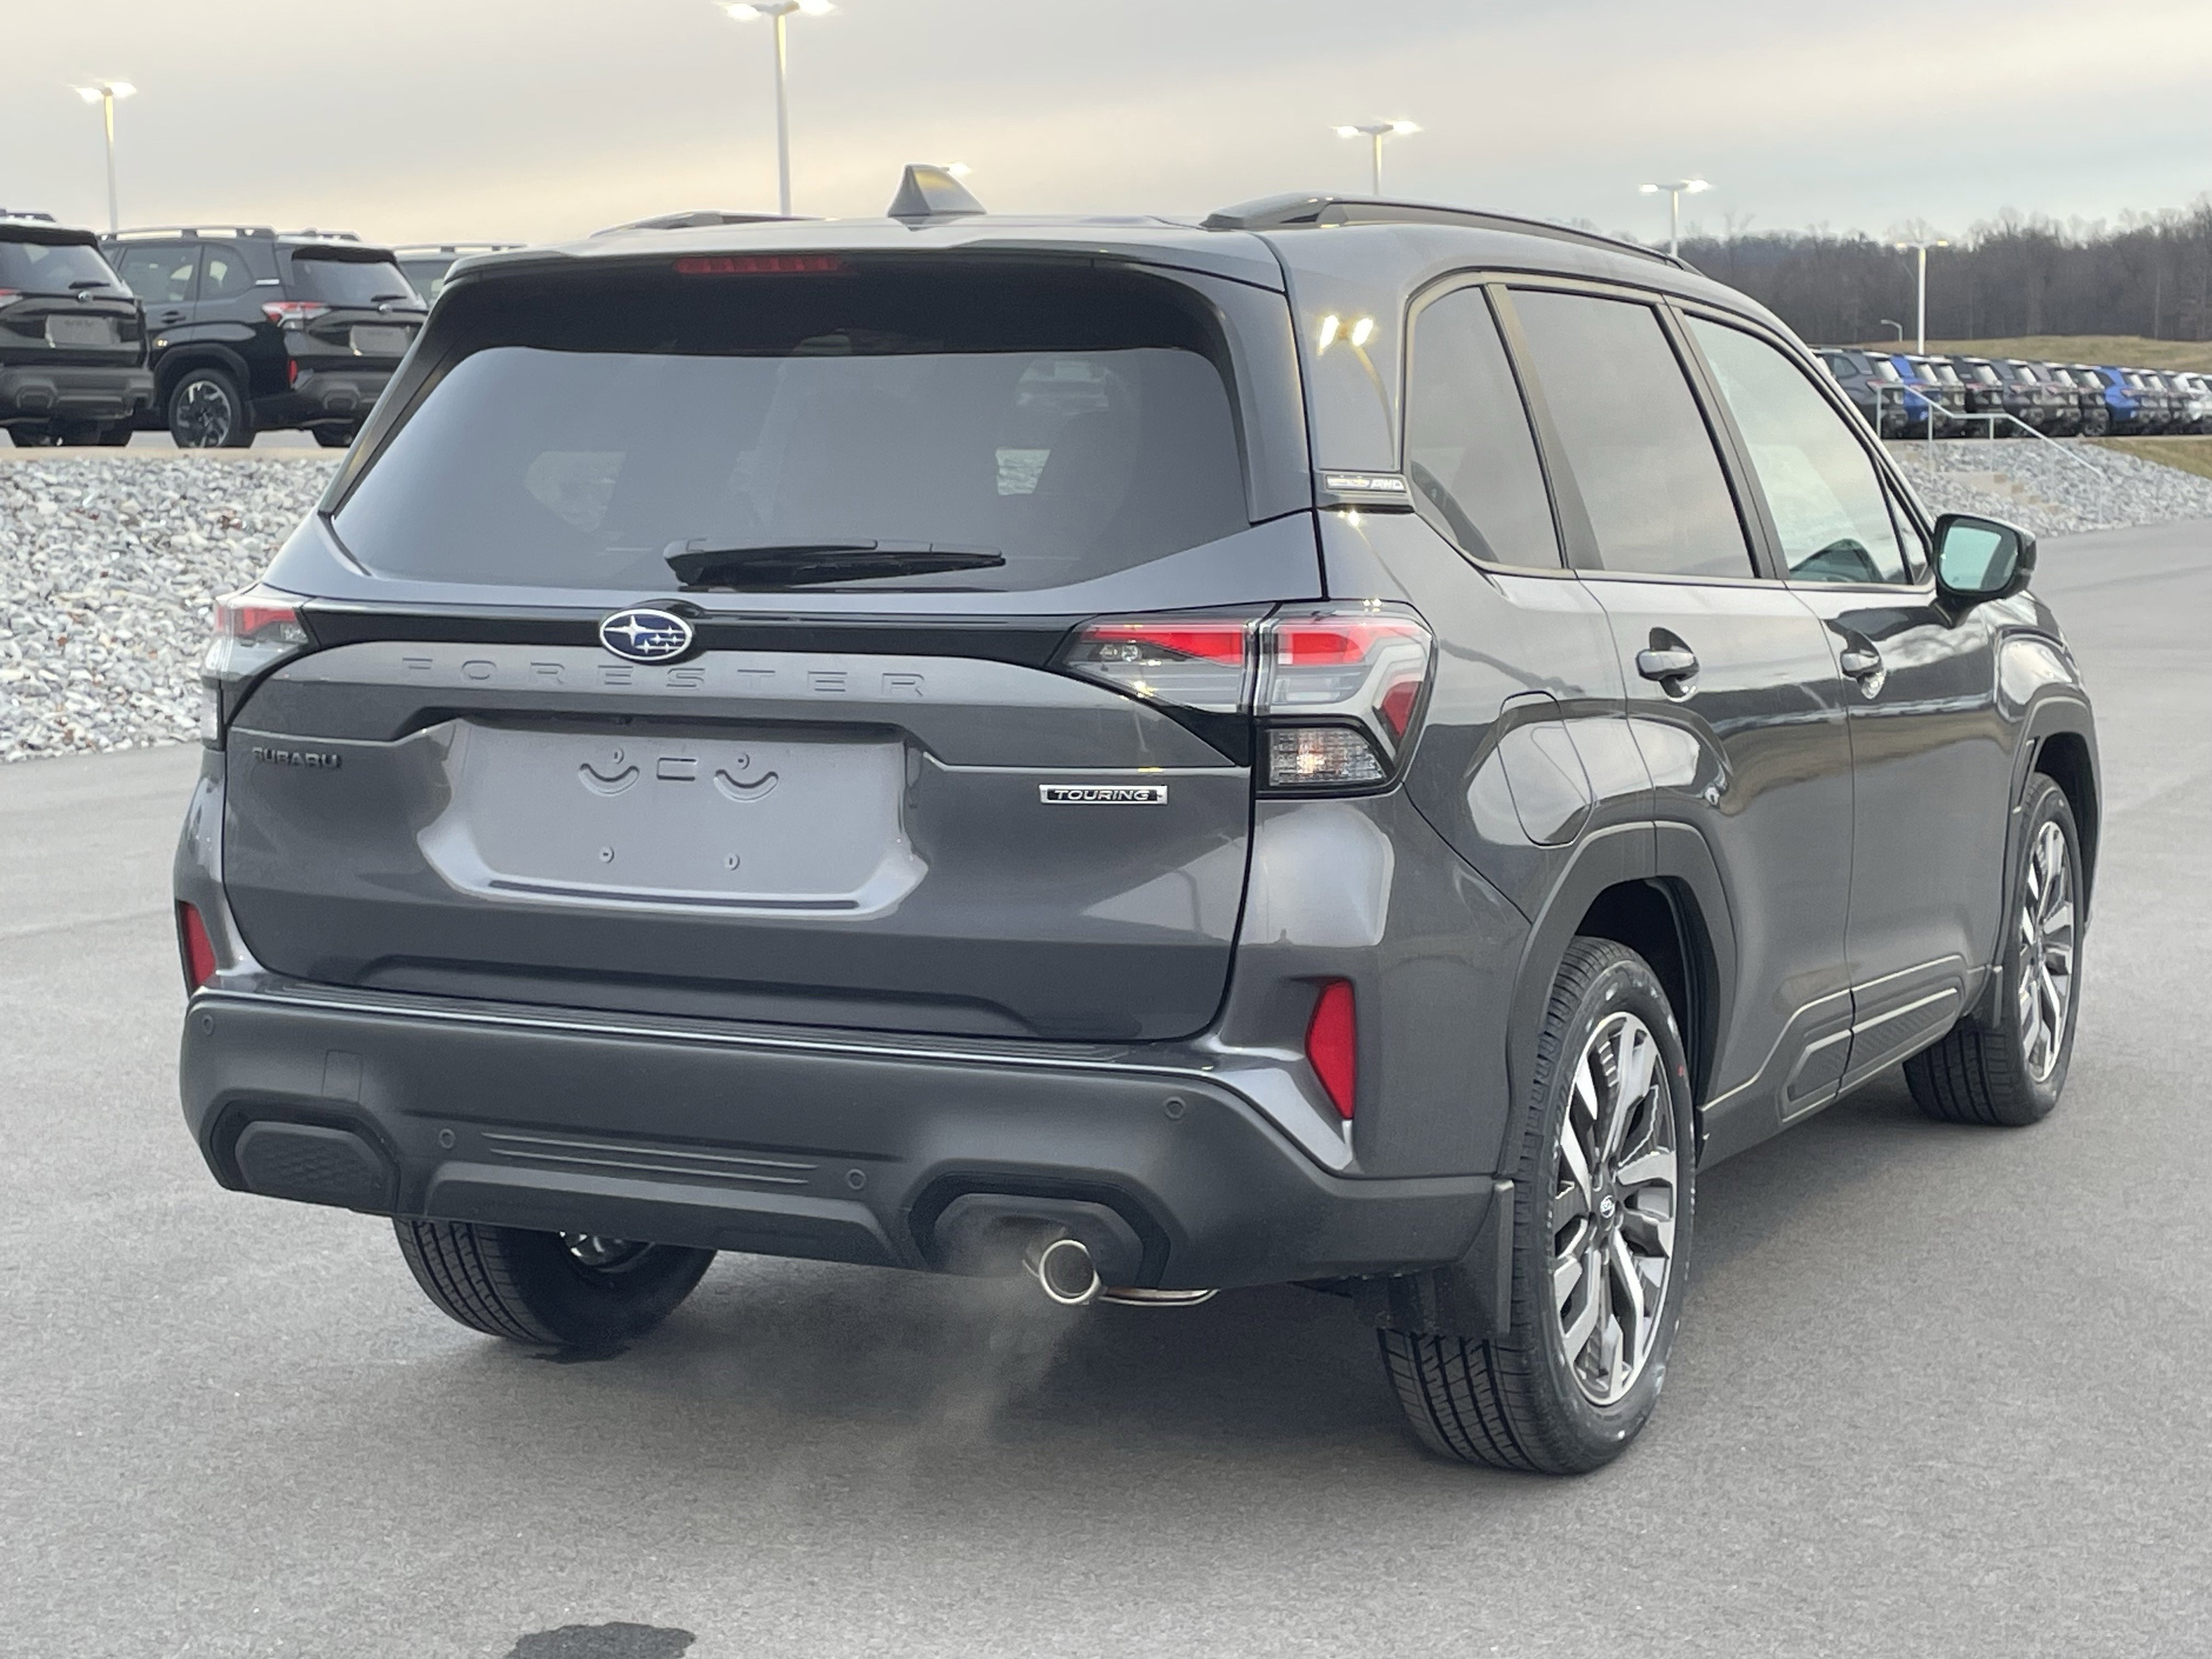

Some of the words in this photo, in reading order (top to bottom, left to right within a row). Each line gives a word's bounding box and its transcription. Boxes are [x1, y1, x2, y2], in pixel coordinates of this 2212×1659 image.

[402, 657, 926, 697] FORESTER
[252, 746, 342, 768] SUBARU
[1054, 789, 1150, 801] TOURING
